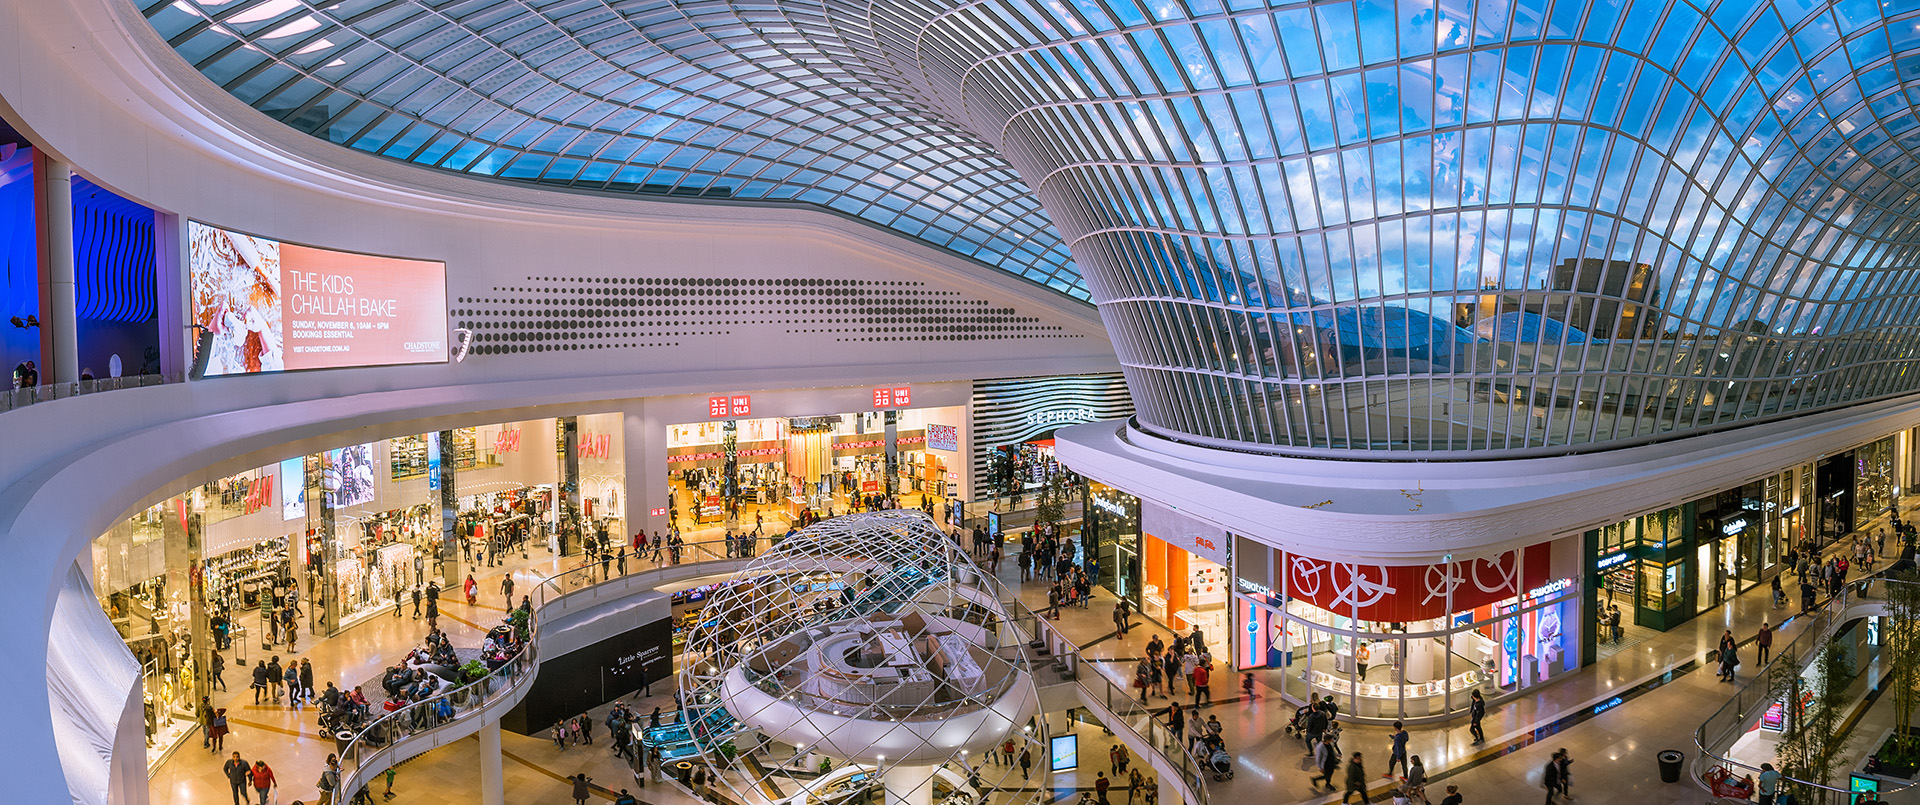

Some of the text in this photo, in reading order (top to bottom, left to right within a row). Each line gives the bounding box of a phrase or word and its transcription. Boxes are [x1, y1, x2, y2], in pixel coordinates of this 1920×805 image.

[289, 270, 354, 295] THE KIDS
[291, 294, 397, 317] CHALLAH BAKE
[292, 320, 317, 330] SUNDAY,
[317, 321, 349, 329] NOVEMBER
[292, 330, 323, 338] BOOKINGS
[293, 345, 304, 353] VISIT
[403, 341, 441, 350] CHADSTONE
[1027, 407, 1095, 425] SEPHORA
[493, 428, 521, 455] H&M
[576, 432, 611, 459] H&M
[244, 474, 274, 515] H&M
[1597, 553, 1627, 568] BODY SHOP
[1239, 577, 1270, 597] swatch
[1529, 579, 1566, 599] swatch
